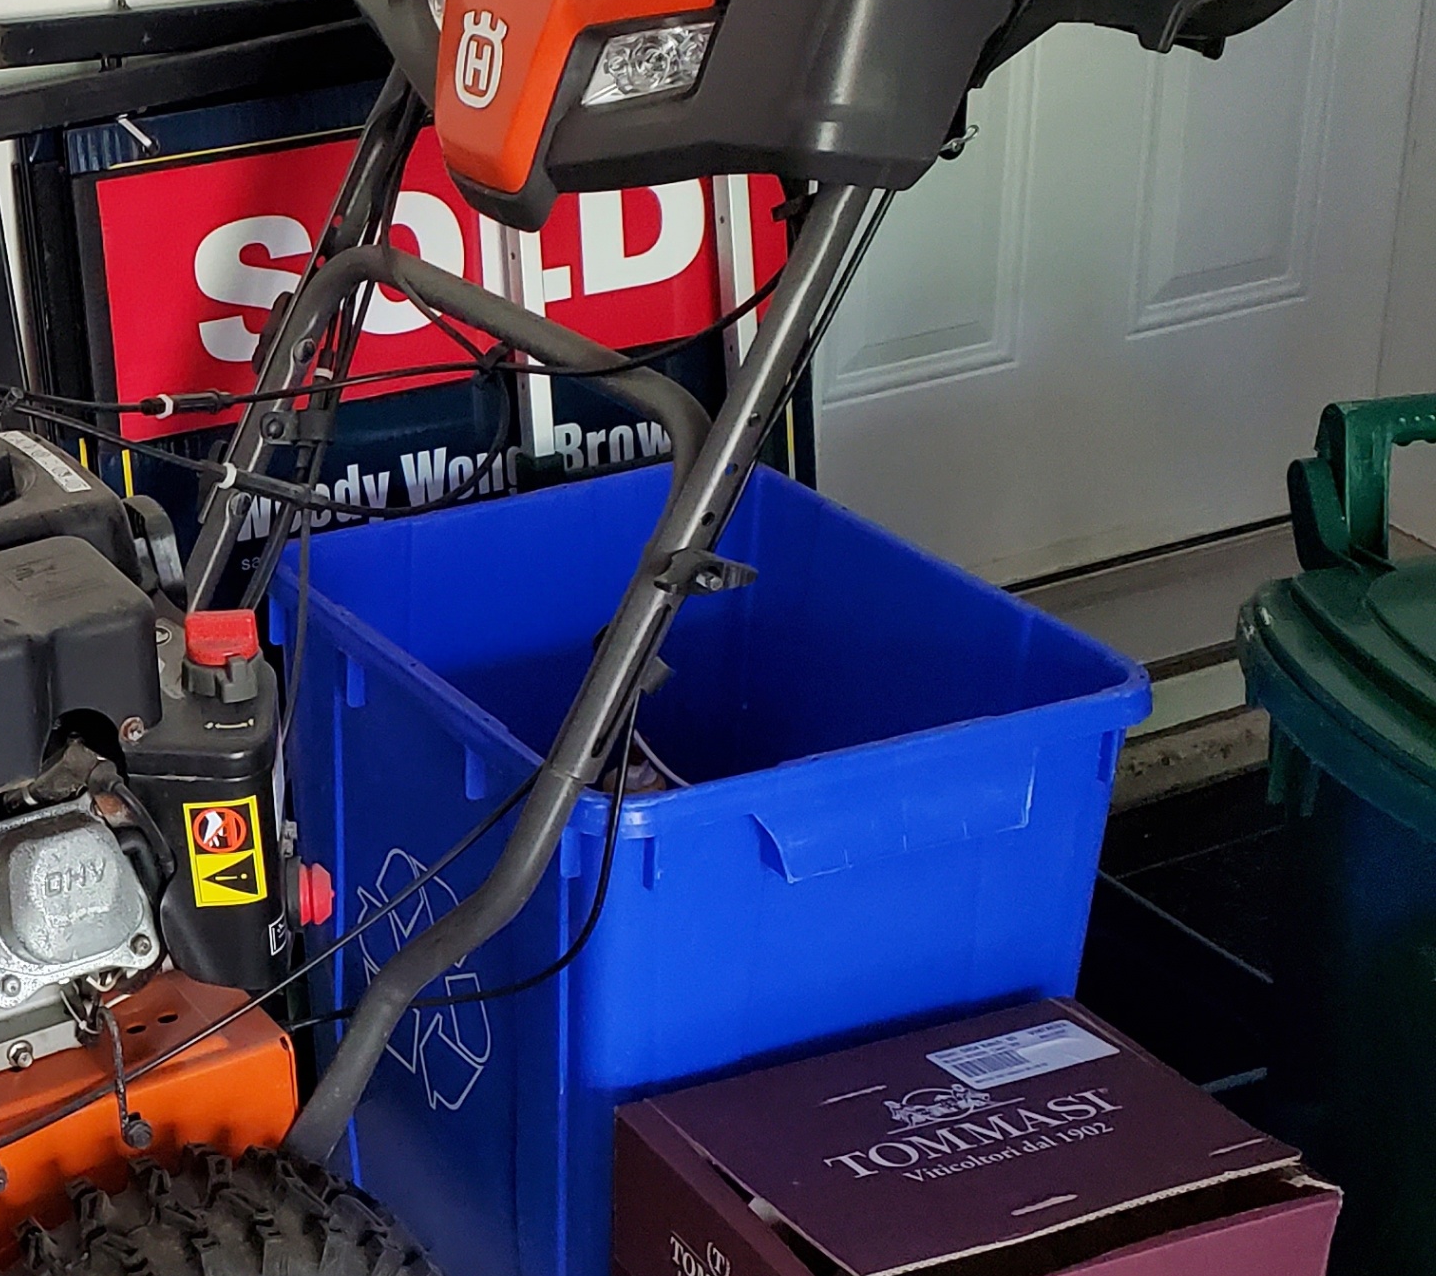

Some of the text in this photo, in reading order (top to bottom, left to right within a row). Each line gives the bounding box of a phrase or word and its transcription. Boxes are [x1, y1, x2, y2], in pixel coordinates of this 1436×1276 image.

[237, 463, 390, 541] Wody
[45, 857, 107, 897] OHV
[823, 1089, 1123, 1179] TOMMASI
[902, 1121, 1114, 1183] Viticoltori dal 1902
